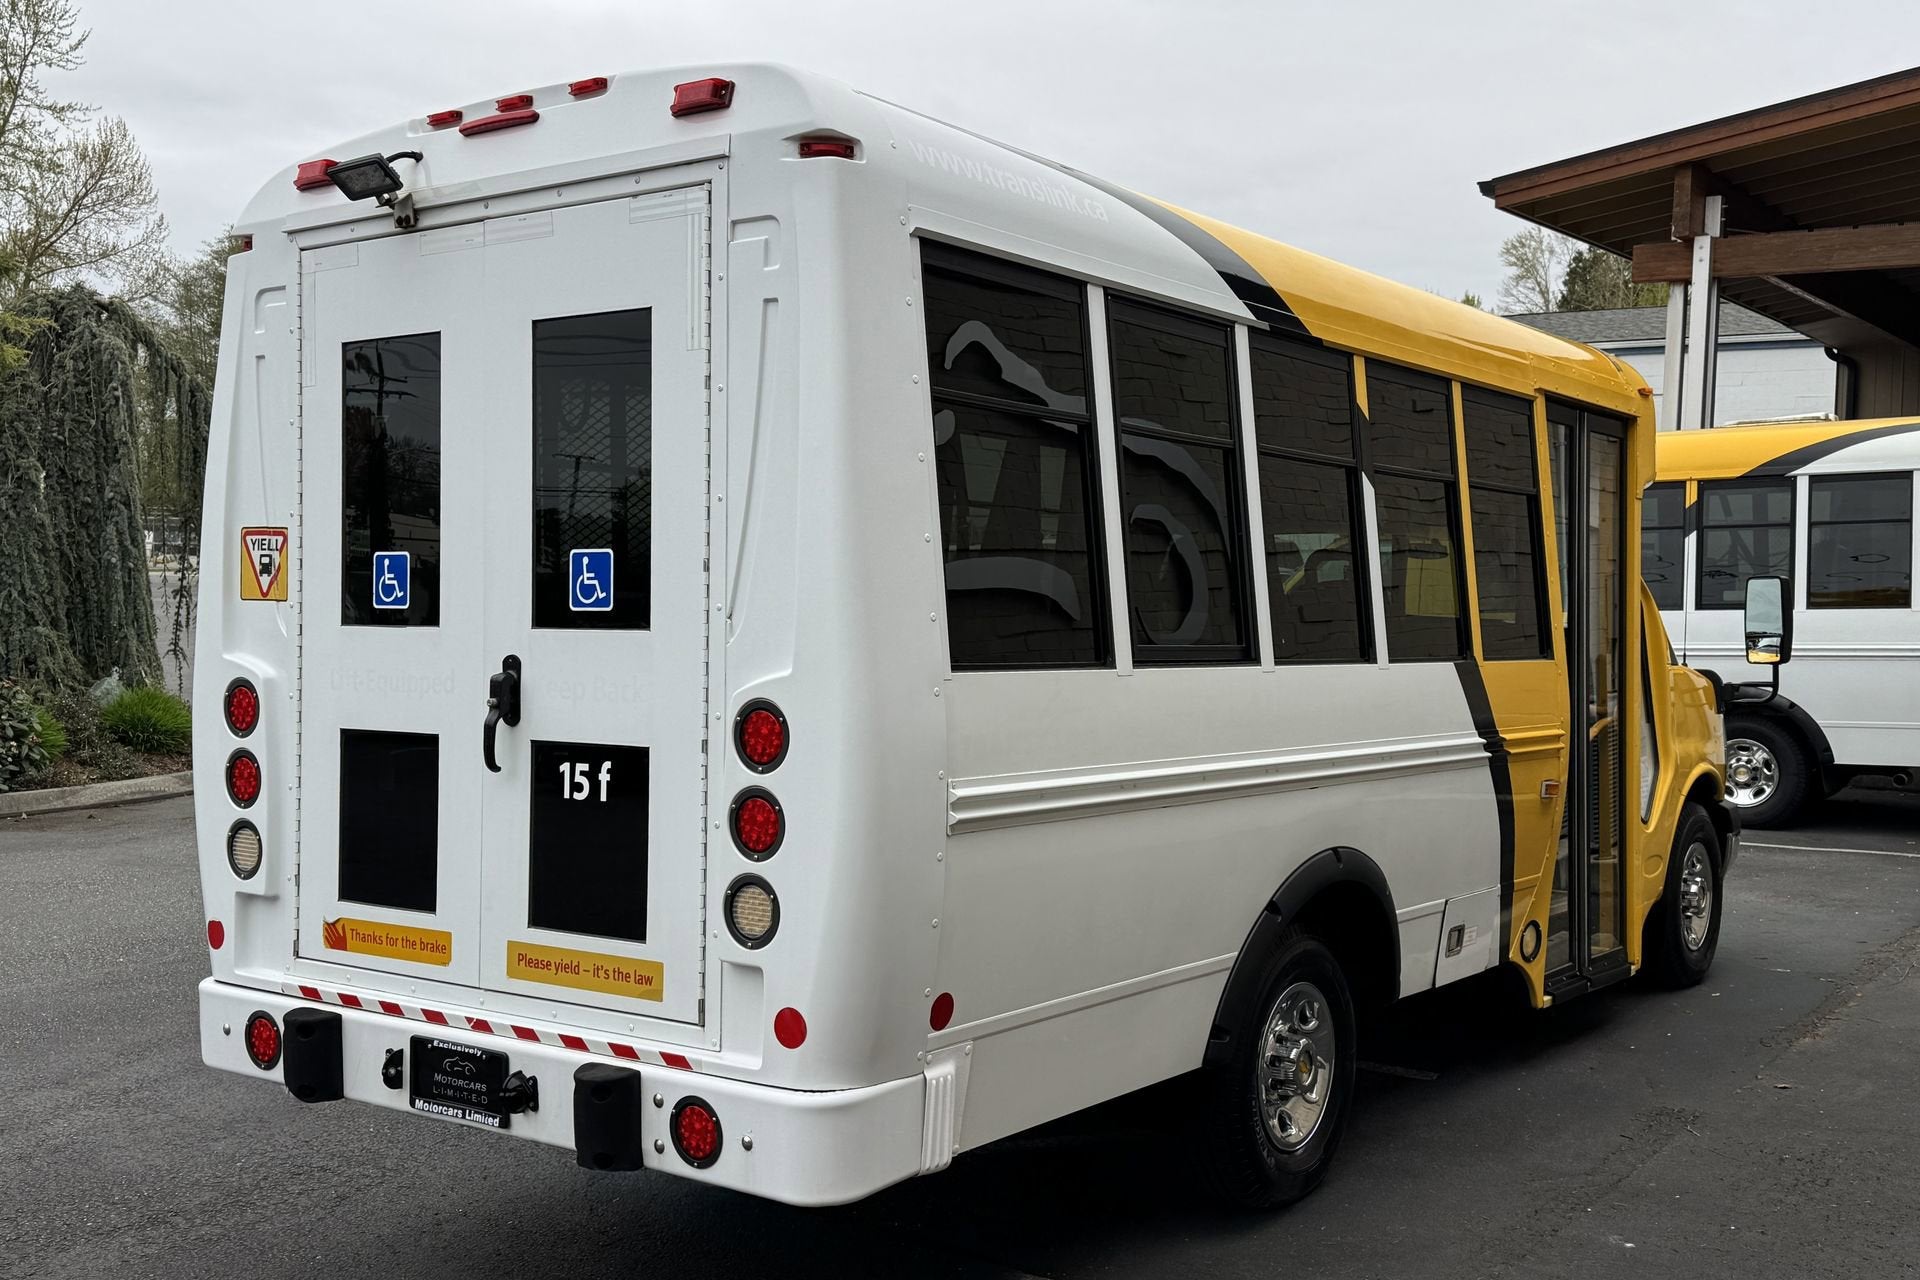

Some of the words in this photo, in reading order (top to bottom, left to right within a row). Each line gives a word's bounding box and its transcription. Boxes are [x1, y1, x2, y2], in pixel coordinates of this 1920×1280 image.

[908, 139, 1110, 223] www.translink.ca
[559, 761, 590, 800] 15
[598, 761, 612, 802] f
[349, 928, 383, 946] Thanks
[386, 933, 399, 947] for
[401, 936, 417, 950] the
[420, 937, 447, 954] brake
[517, 953, 552, 970] Please
[554, 958, 580, 975] yield
[613, 967, 631, 983] the
[634, 969, 654, 986] law
[433, 1040, 482, 1057] Exclusively
[434, 1073, 487, 1092] MOTORCARS
[415, 1099, 463, 1118] Motorcars
[466, 1109, 500, 1127] Limited
